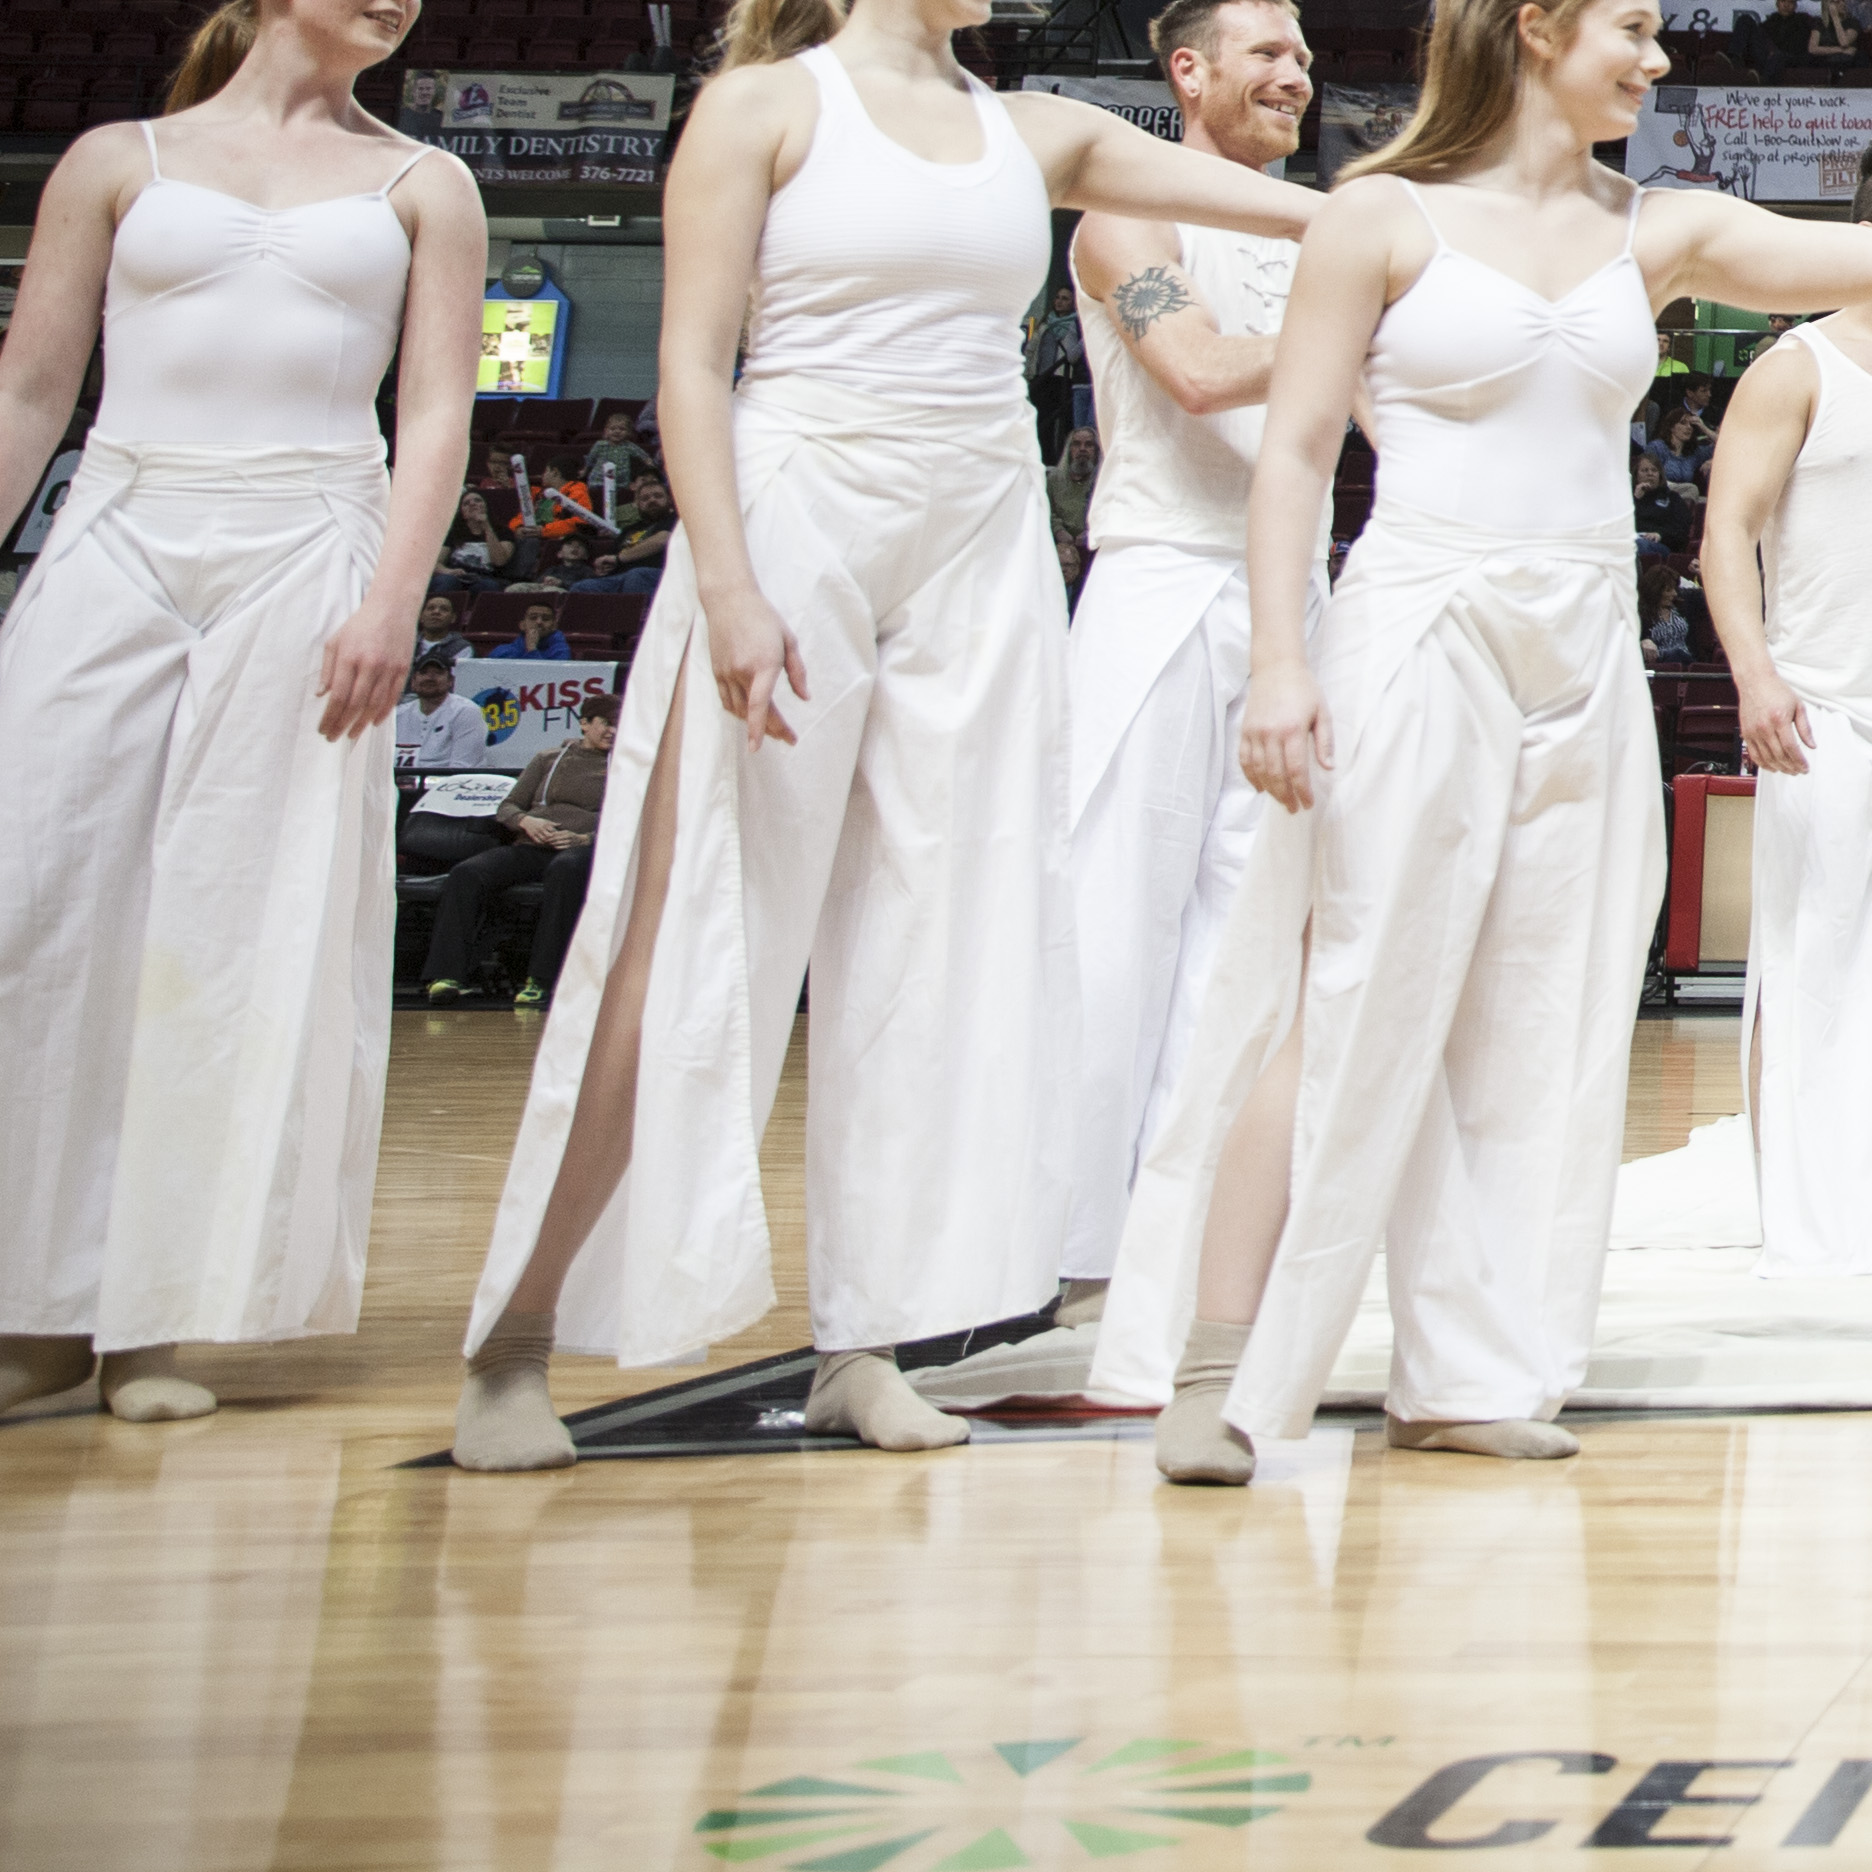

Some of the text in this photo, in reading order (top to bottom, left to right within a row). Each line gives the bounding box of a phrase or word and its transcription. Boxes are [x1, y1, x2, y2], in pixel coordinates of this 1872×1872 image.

[1763, 93, 1782, 109] got
[1704, 104, 1750, 130] FREE
[1752, 109, 1784, 133] help
[1787, 115, 1802, 129] to
[1805, 113, 1837, 133] quit
[414, 134, 662, 157] AMILY DENTISTRY
[1723, 132, 1748, 146] Call
[478, 677, 607, 732] 3.5 KISS
